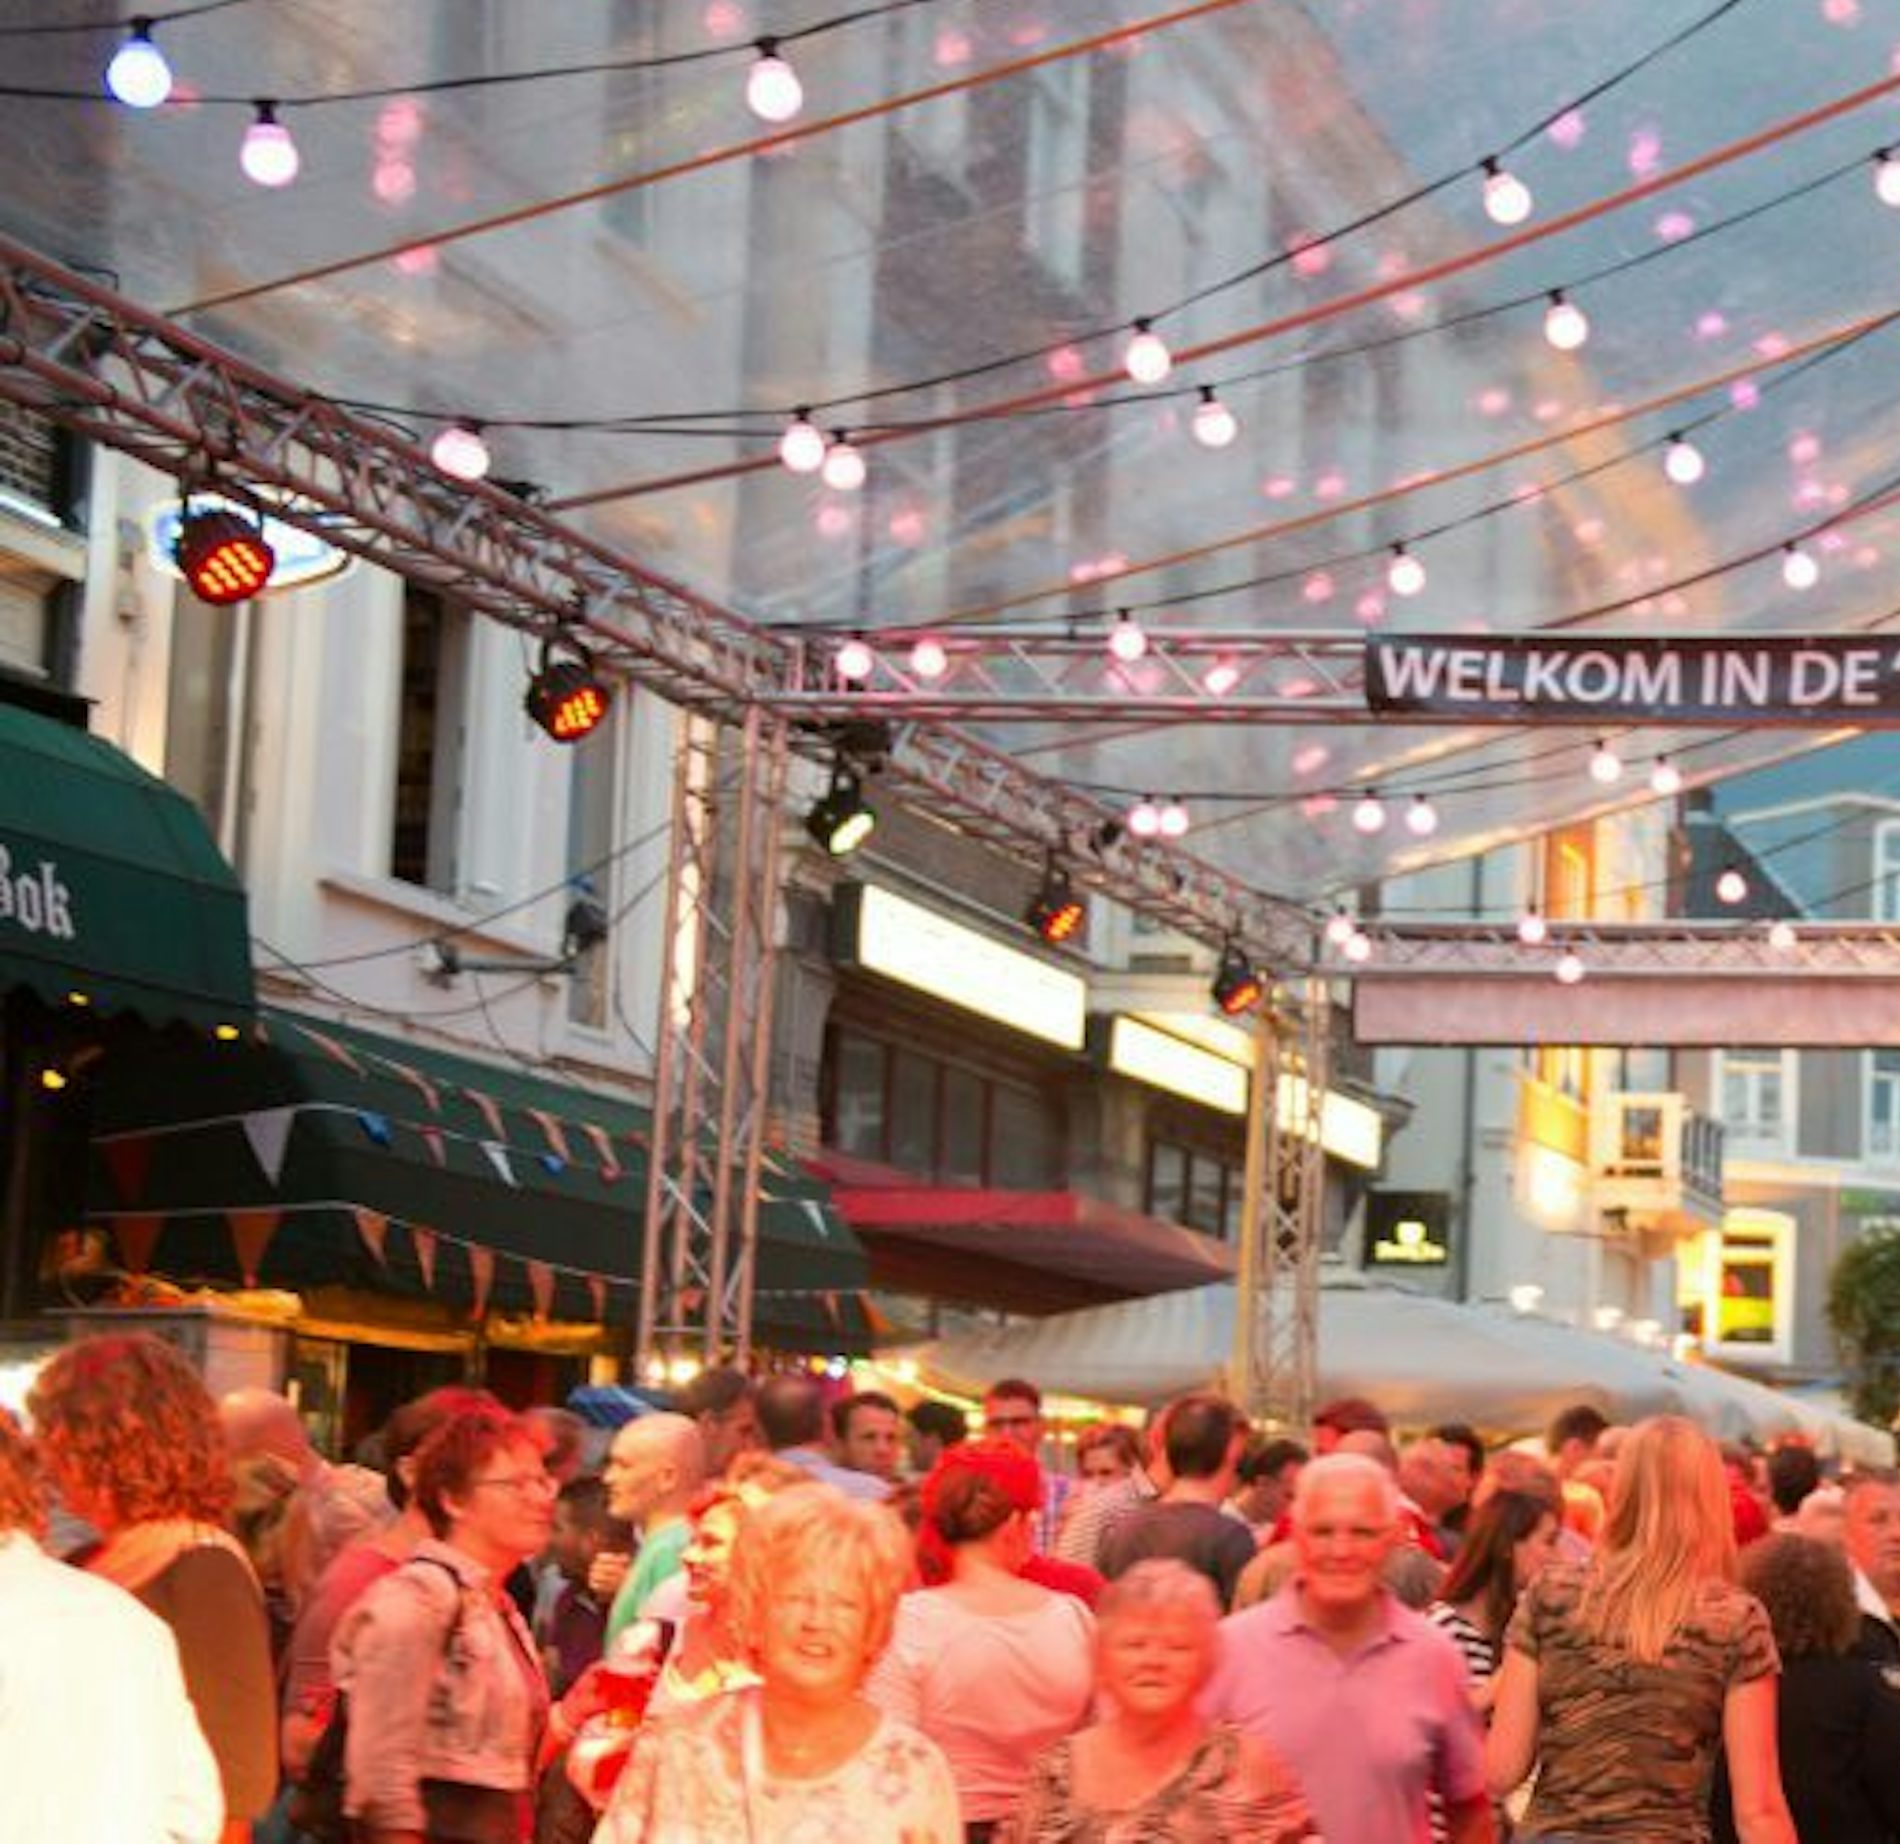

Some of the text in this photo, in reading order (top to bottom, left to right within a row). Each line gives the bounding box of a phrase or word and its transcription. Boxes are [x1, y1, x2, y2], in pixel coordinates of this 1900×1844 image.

[1379, 644, 1682, 706] WELKOM
[1701, 651, 1769, 706] IN
[1788, 649, 1880, 705] DE
